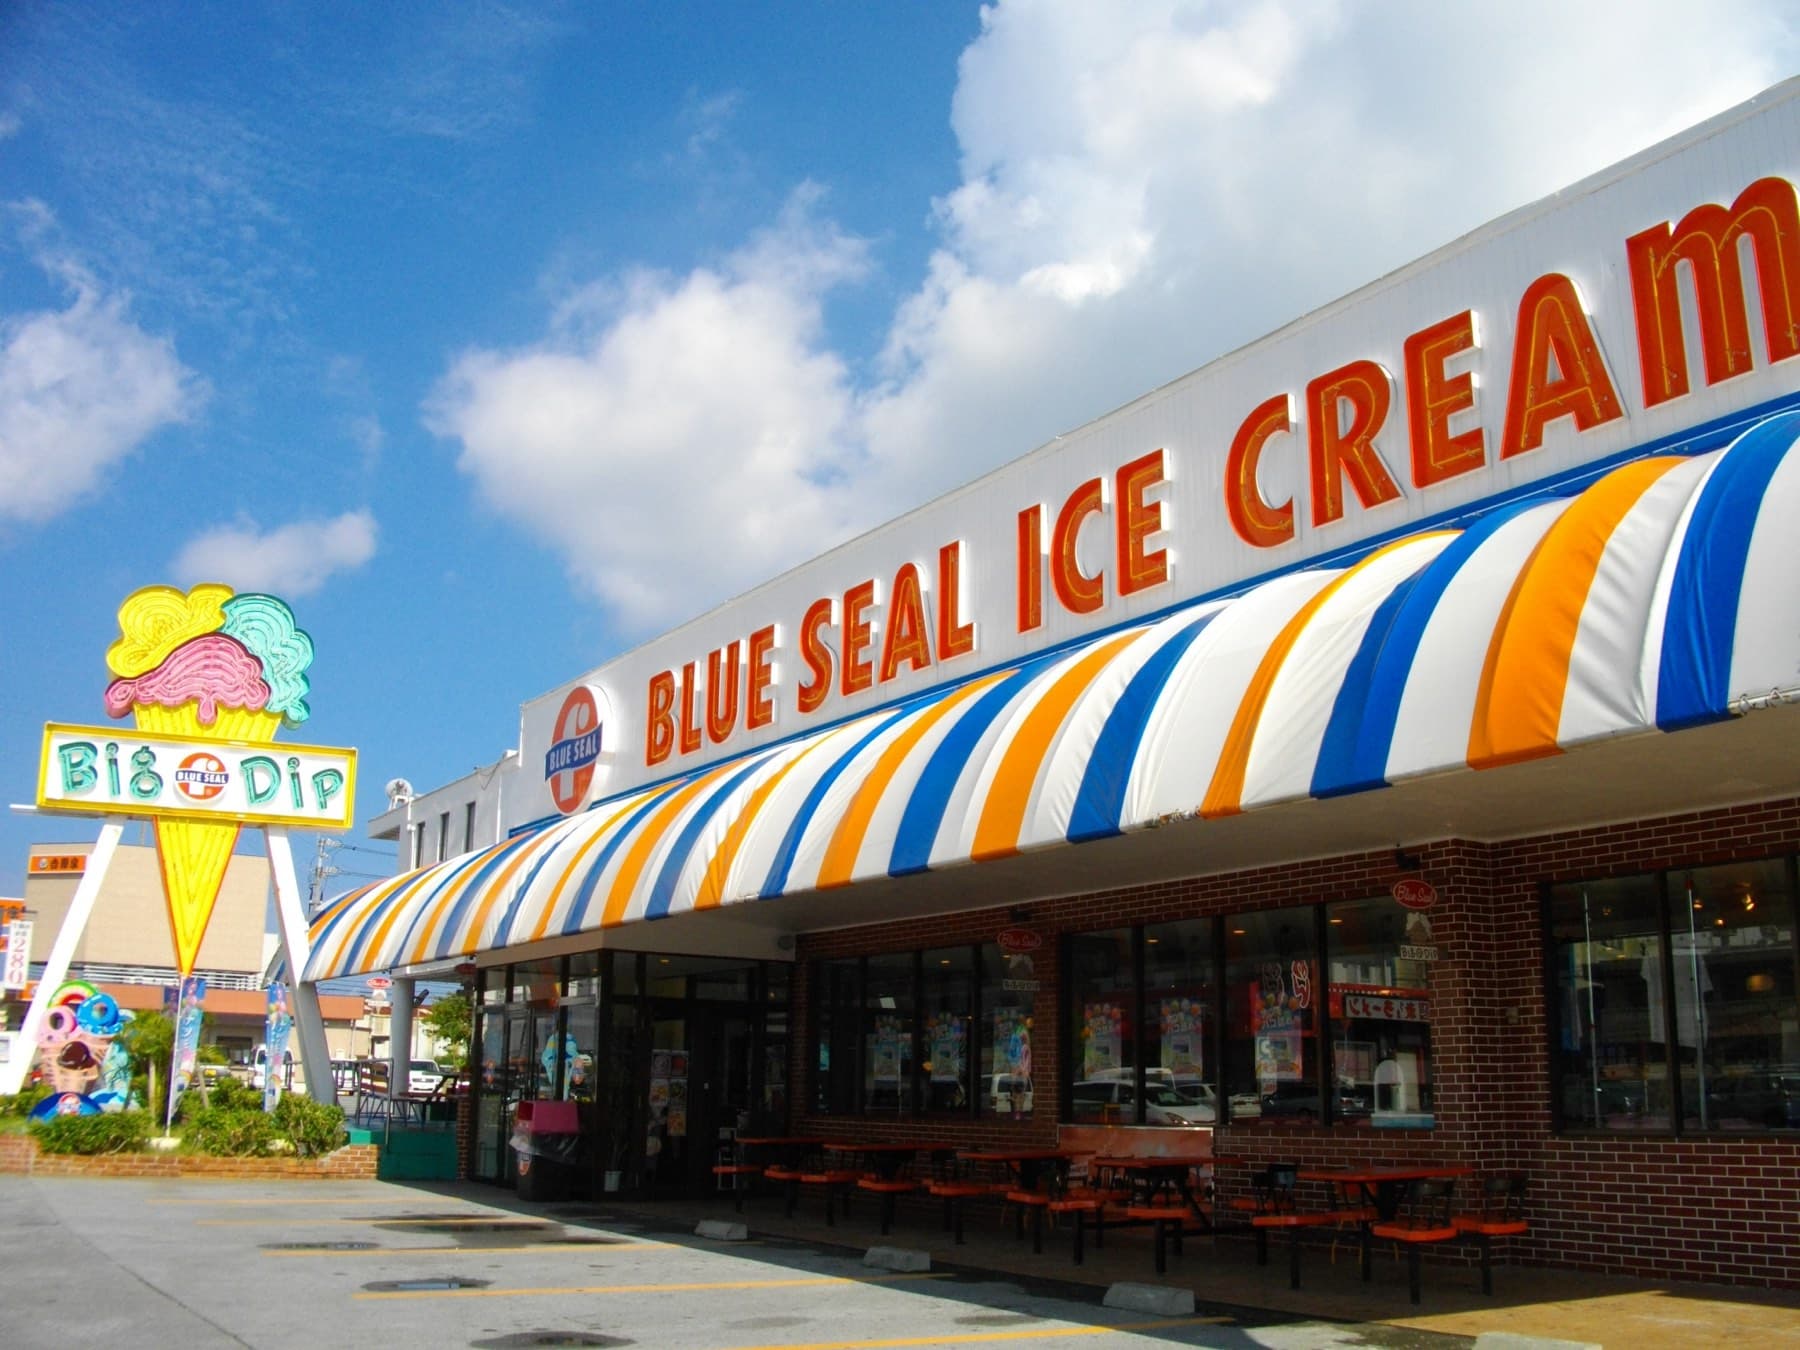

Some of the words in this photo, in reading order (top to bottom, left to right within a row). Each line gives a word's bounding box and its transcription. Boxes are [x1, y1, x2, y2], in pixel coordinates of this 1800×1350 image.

[645, 640, 774, 767] BLUE
[797, 541, 974, 714] SEAL
[1017, 448, 1168, 634] ICE
[549, 743, 571, 771] BLUE
[573, 733, 597, 761] SEAL
[177, 771, 202, 782] BLUE
[204, 773, 226, 783] SEAL
[1397, 884, 1417, 902] Blue
